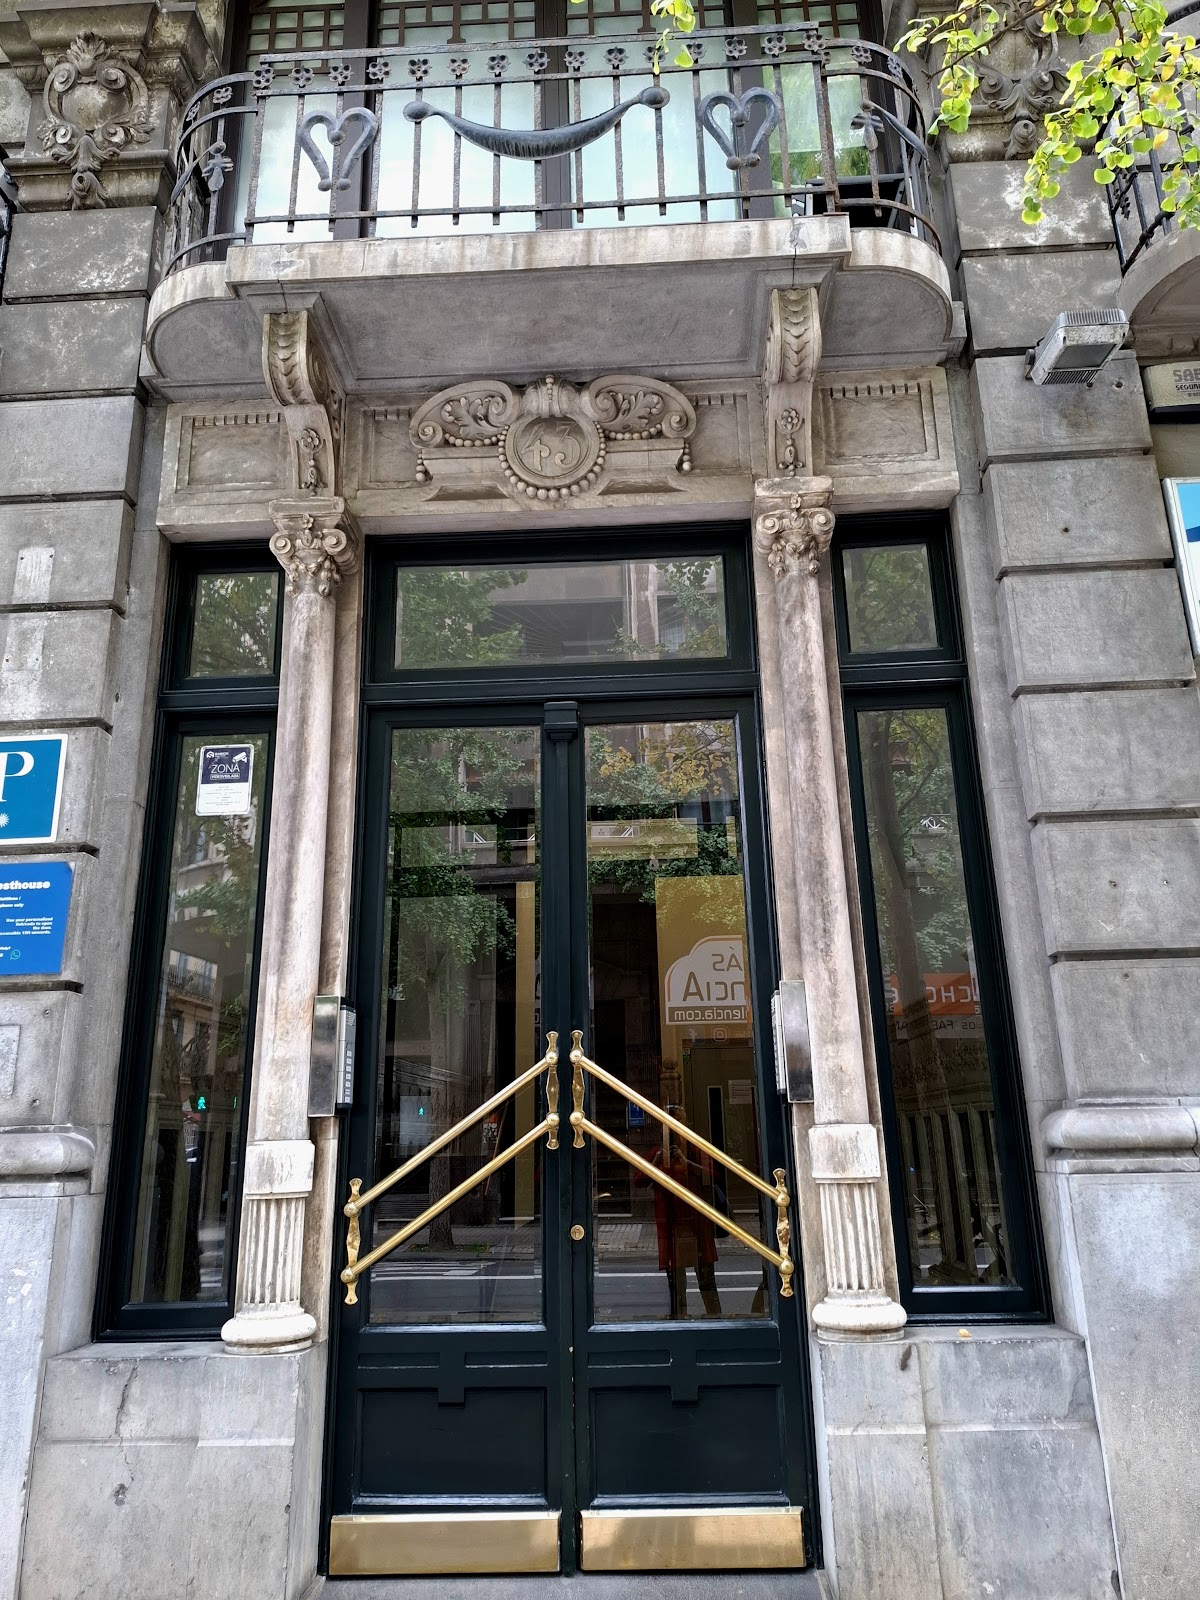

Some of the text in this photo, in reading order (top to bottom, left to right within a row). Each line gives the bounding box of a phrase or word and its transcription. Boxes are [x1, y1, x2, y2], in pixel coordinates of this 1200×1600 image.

[520, 421, 581, 472] 43
[0, 751, 35, 803] P
[211, 763, 240, 774] ZONA
